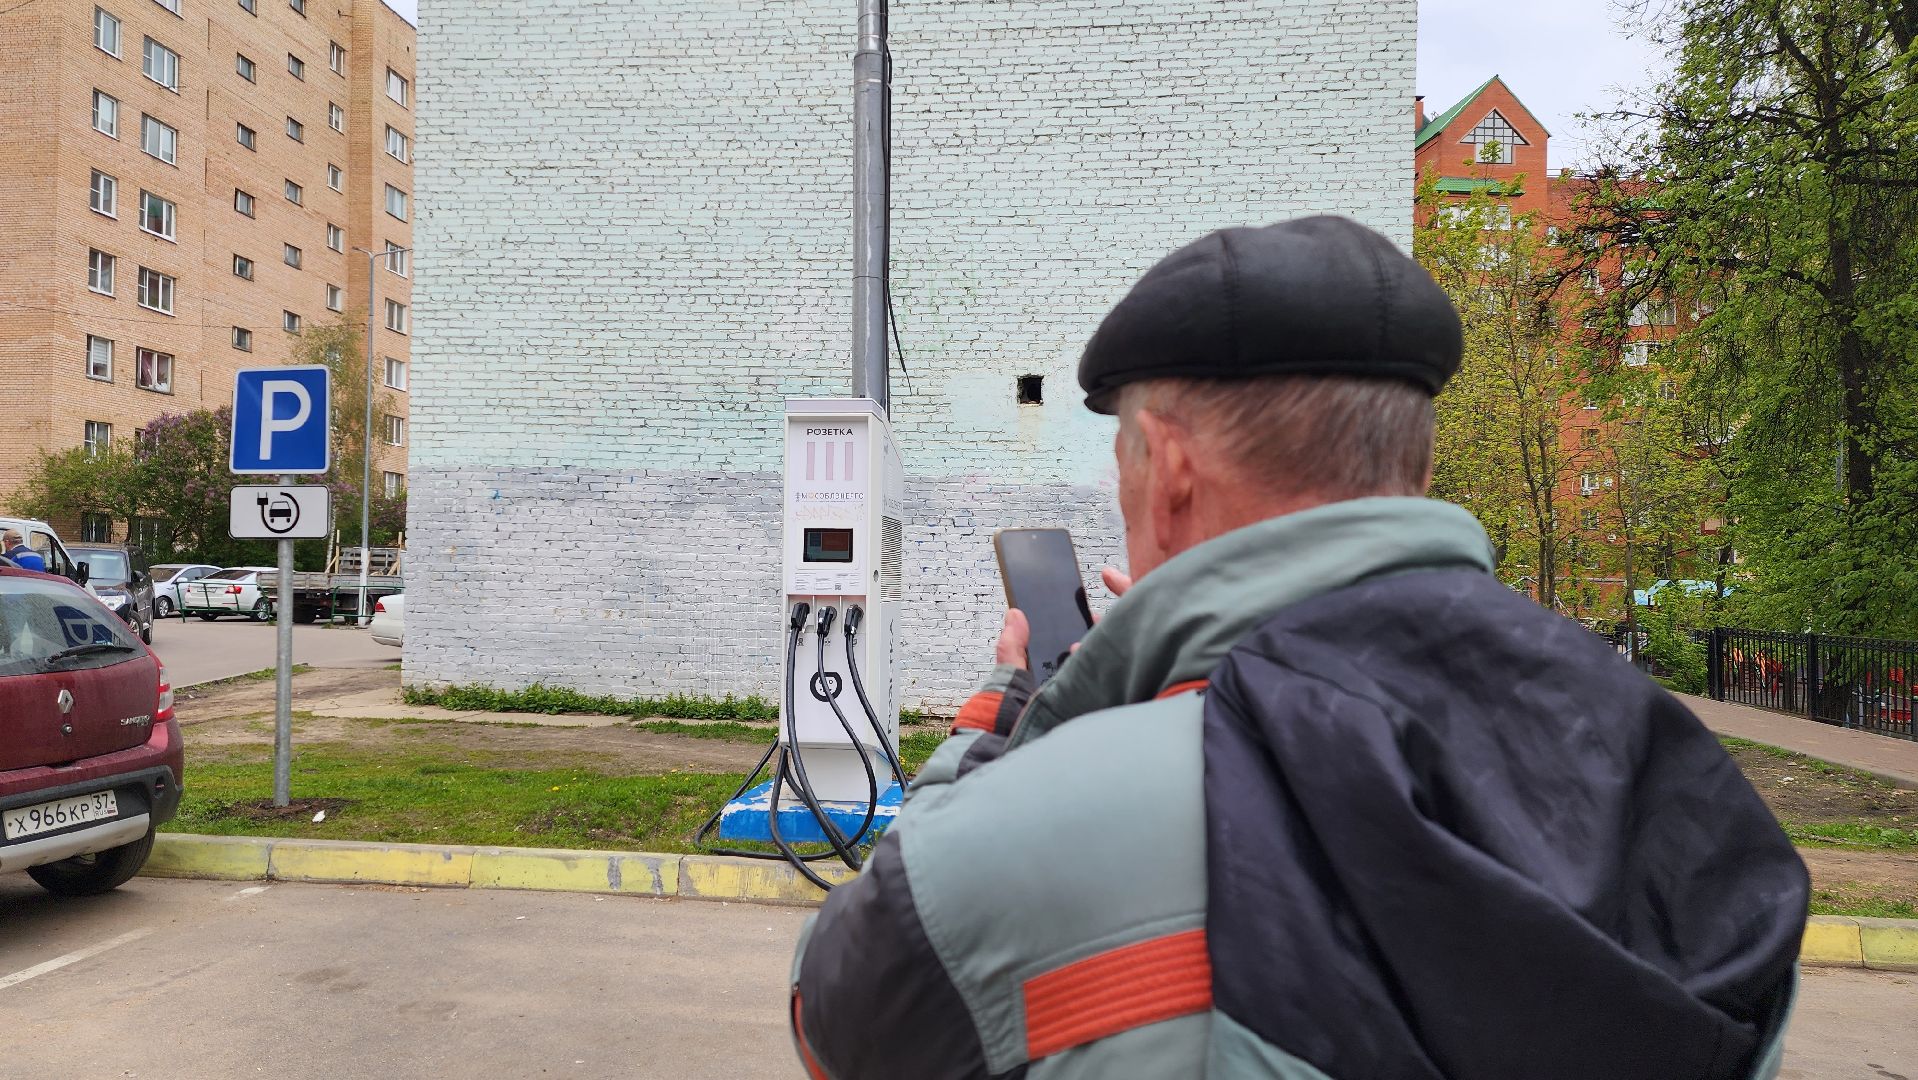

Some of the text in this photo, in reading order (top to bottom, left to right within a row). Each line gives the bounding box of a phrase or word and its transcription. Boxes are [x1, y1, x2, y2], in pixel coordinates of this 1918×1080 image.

[259, 380, 312, 460] P
[806, 428, 854, 436] РОЗЕТКА
[14, 794, 109, 834] Х966КР 37
